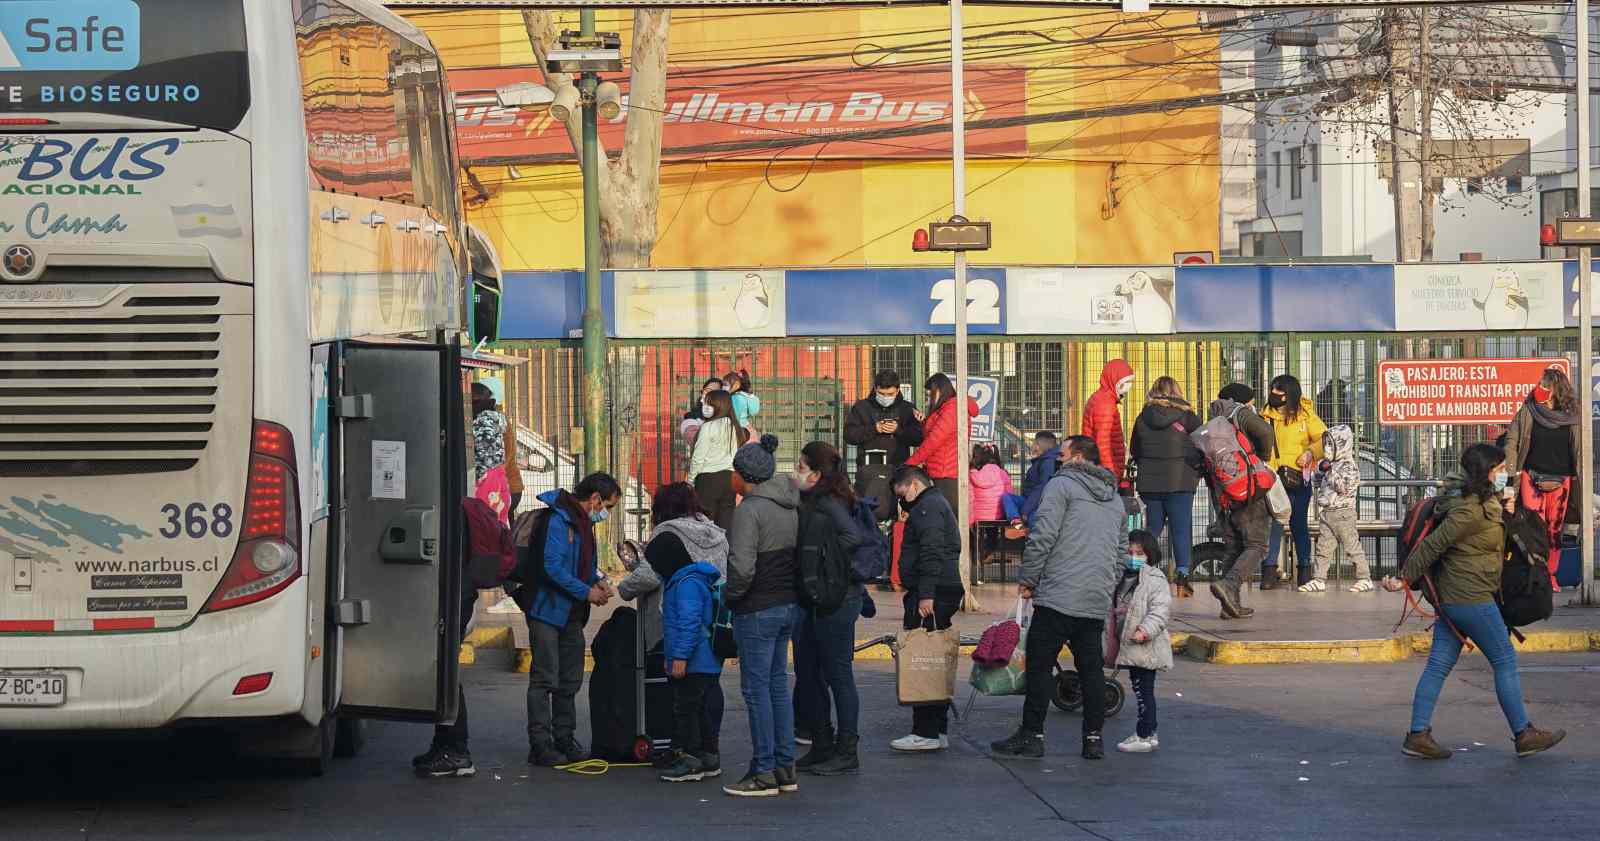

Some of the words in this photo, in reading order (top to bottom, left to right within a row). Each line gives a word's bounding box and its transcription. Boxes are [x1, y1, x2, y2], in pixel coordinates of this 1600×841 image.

[26, 16, 125, 52] Safe
[40, 84, 200, 102] BIOSEGURO
[17, 136, 180, 181] BUS
[2, 184, 142, 195] ACIONAL
[25, 202, 128, 239] Cama
[929, 278, 1000, 325] 22
[1407, 366, 1469, 381] PASAJERO:
[1470, 365, 1498, 380] ESTA
[1386, 384, 1446, 399] PROHIBIDO
[1449, 383, 1513, 398] TRANSITAR
[1386, 403, 1417, 417] PATIO
[1420, 402, 1434, 416] DE
[1436, 401, 1497, 416] MANIOBRA
[1500, 401, 1514, 415] DE
[159, 502, 233, 539] 368
[74, 556, 219, 573] www.narbus.cl
